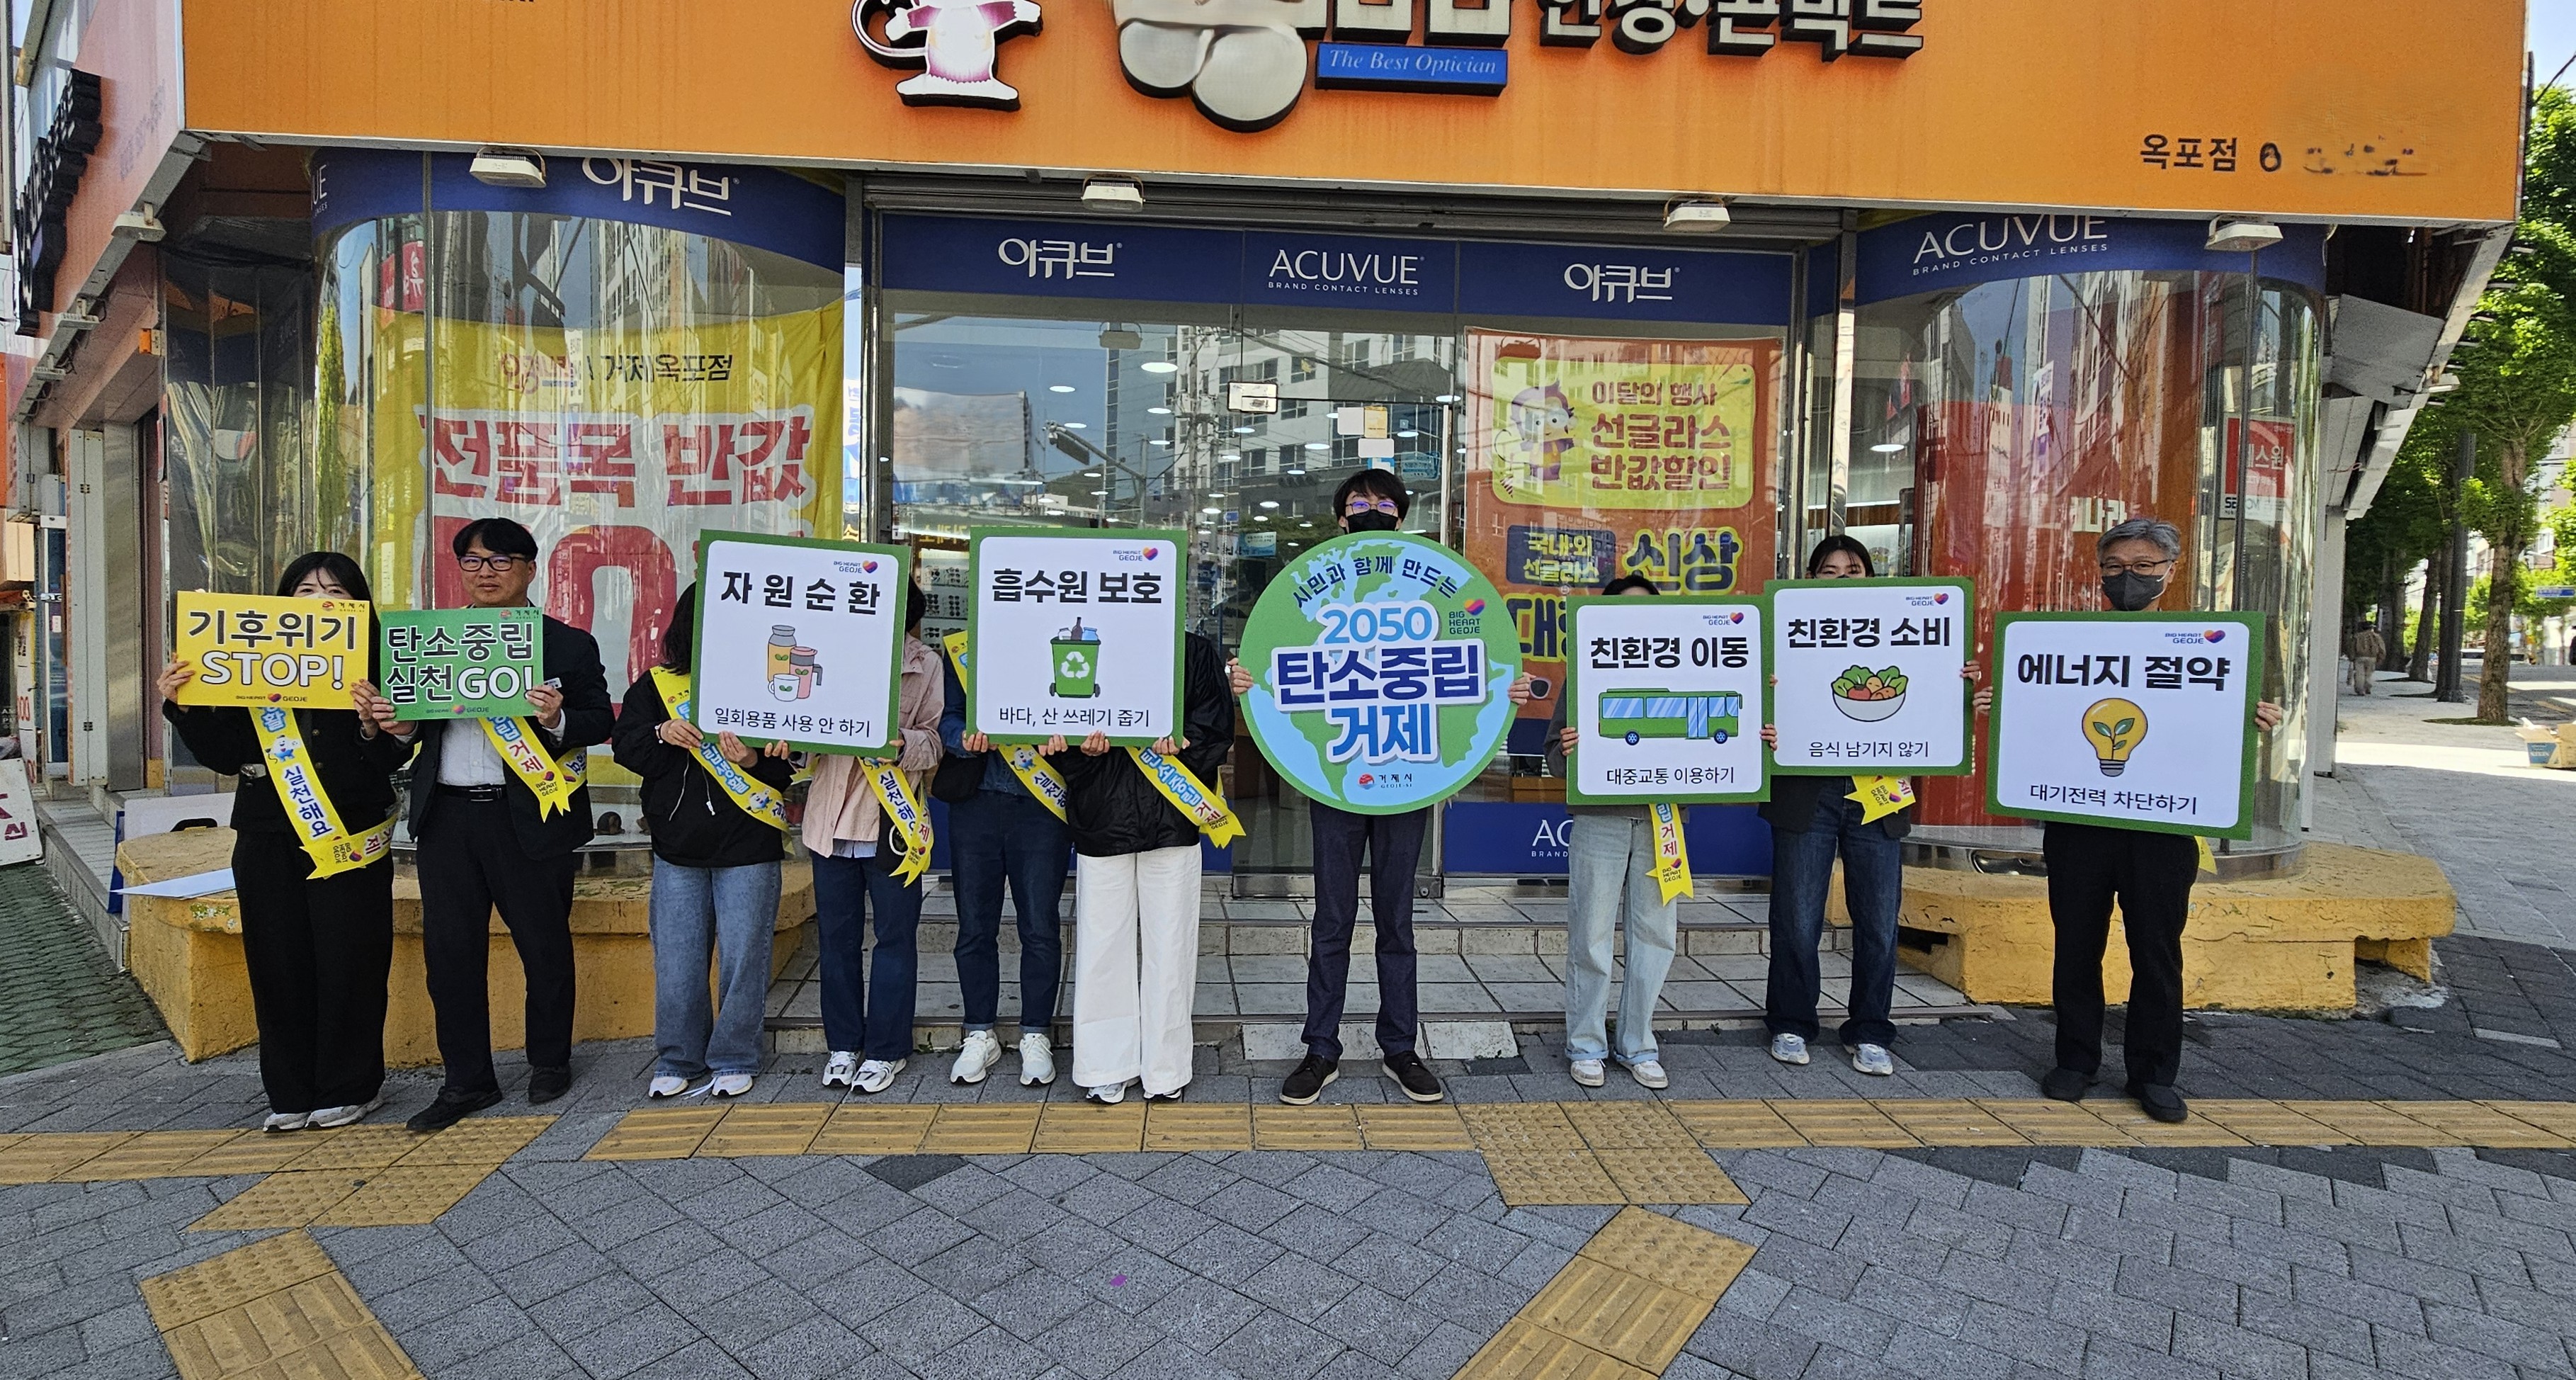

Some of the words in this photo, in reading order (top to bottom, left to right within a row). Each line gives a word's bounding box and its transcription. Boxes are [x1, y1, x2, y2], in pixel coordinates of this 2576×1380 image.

[1330, 49, 1363, 69] The
[1370, 51, 1409, 70] Best
[1417, 54, 1496, 77] Optician
[2140, 133, 2237, 172] 옥포점
[581, 157, 732, 216] 아큐브
[1913, 214, 2108, 264] ACUVUE
[998, 237, 1116, 280] 아큐브
[1269, 249, 1419, 285] ACUVUE
[1913, 260, 1961, 276] BRAND
[1970, 249, 2041, 265] CONTACT
[2050, 244, 2108, 255] LENSES
[1268, 281, 1307, 290] BRAND
[1315, 284, 1368, 293] CONTACT
[1375, 287, 1418, 295] LENSES
[1564, 262, 1673, 303] 아큐브
[600, 354, 732, 383] 거제옥포점
[1591, 380, 1663, 407] 이달의
[1669, 381, 1718, 407] 행사
[1591, 413, 1732, 450] 선글라스
[419, 414, 636, 508] 전품목
[663, 415, 811, 507] 반값
[1591, 454, 1731, 492] 반값할인
[1524, 559, 1600, 584] 선글라스
[1626, 531, 1740, 591] 신상
[992, 568, 1088, 604] 흡수원
[1098, 572, 1162, 604] 보호
[1293, 562, 1346, 609] 시민과
[1353, 556, 1393, 577] 함께
[1402, 558, 1459, 599] 만드는
[188, 609, 356, 650] 기후위기
[1322, 606, 1432, 644] 2050
[1448, 618, 1481, 626] HEART
[1449, 626, 1480, 635] GEOJE
[1788, 617, 1880, 649] 친환경
[1890, 617, 1951, 647] 소비
[388, 623, 533, 664] 탄소중립
[1590, 636, 1681, 669] 친환경
[1691, 637, 1749, 669] 이동
[200, 650, 344, 690] STOP!
[1277, 645, 1480, 705] 탄소중립
[2018, 653, 2130, 688] 에너지
[2144, 656, 2230, 691] 절약
[715, 708, 778, 730] 일회용품
[782, 714, 814, 733] 사용
[818, 718, 834, 735] 안
[839, 719, 870, 738] 하기
[999, 707, 1036, 727] 바다,
[1042, 708, 1058, 725] 산
[1063, 708, 1112, 727] 쓰레기
[1117, 709, 1150, 727] 줍기
[1332, 703, 1432, 757] 거제
[509, 740, 545, 772] 거제
[1809, 742, 1840, 758] 음식
[1846, 741, 1893, 758] 남기지
[1898, 741, 1929, 758] 않기
[1378, 773, 1412, 784] 거제시
[1606, 767, 1669, 786] 대중교통
[1674, 767, 1735, 784] 이용하기
[285, 765, 333, 838] 실천해요
[2030, 784, 2106, 807] 대기전력
[2113, 791, 2197, 815] 차단하기
[1661, 823, 1677, 856] 거제
